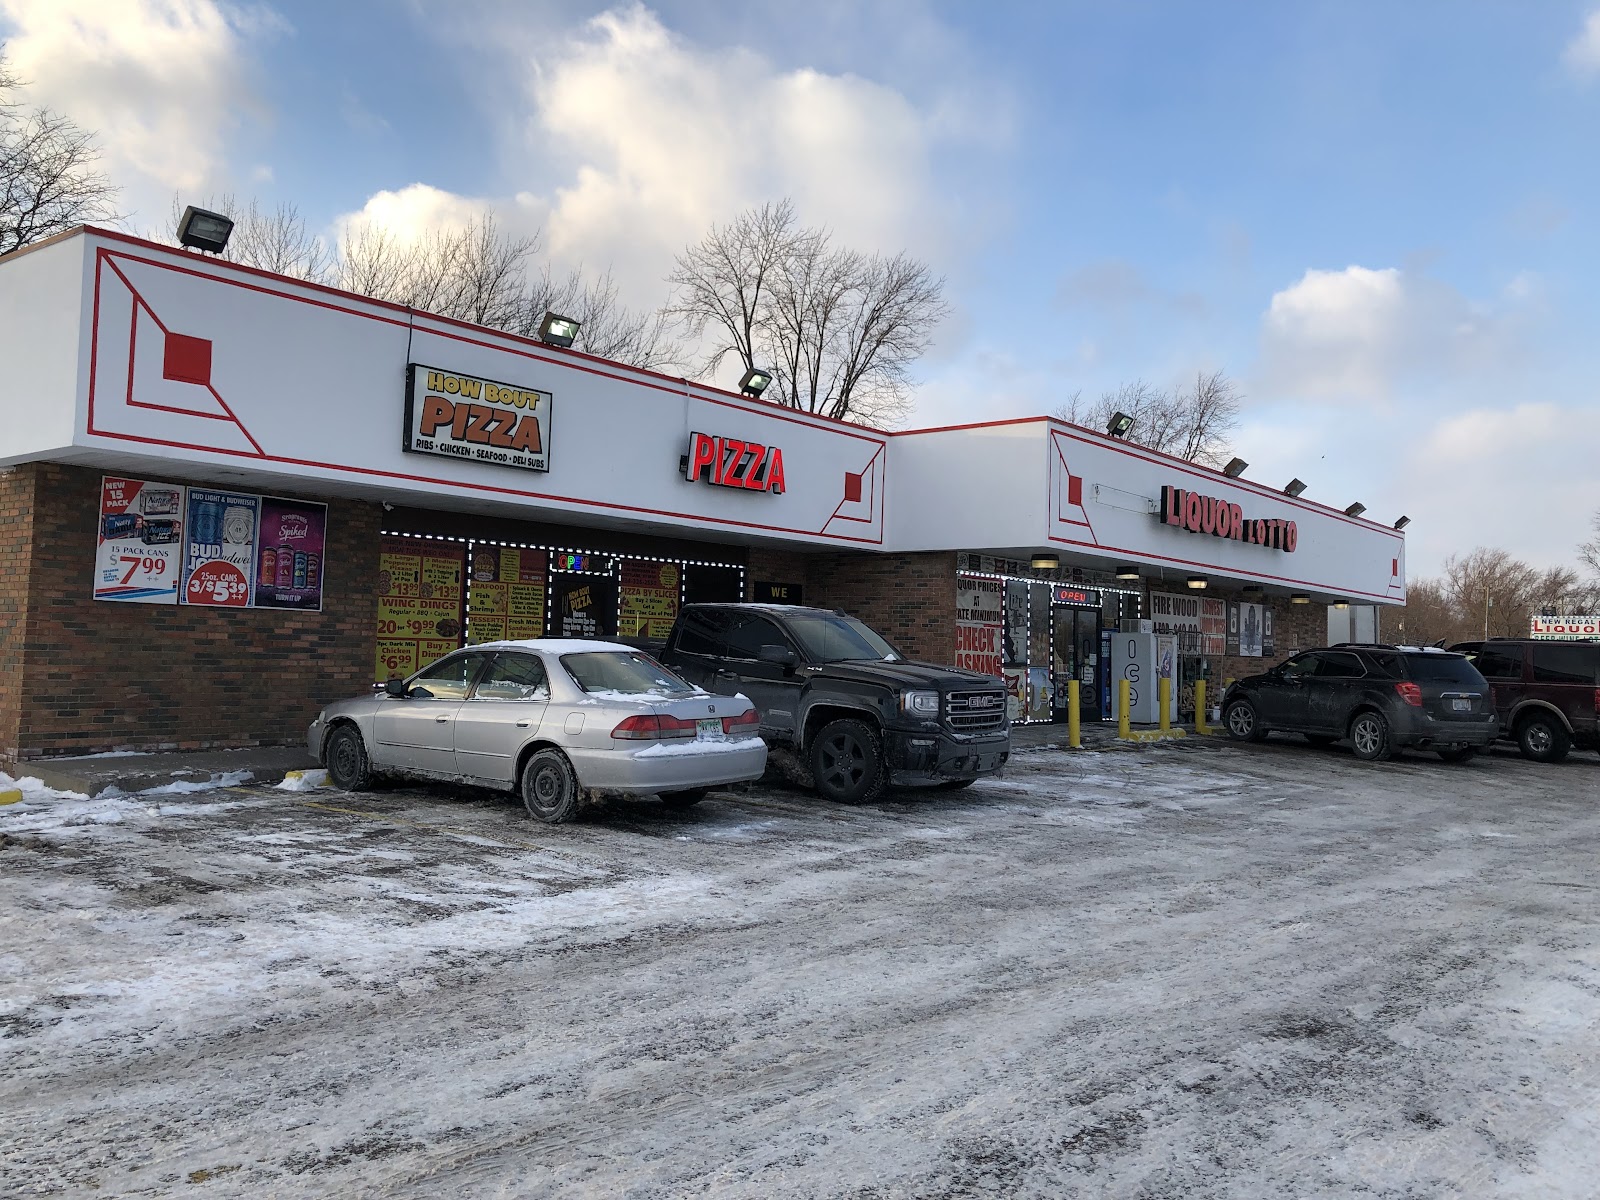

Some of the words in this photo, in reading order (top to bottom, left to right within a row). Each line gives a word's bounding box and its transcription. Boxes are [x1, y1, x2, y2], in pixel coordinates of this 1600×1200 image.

[428, 372, 482, 399] HOW
[484, 384, 540, 410] BOUT
[420, 396, 542, 454] PIZZA
[416, 439, 434, 450] RIBS
[440, 443, 470, 456] CHICKEN
[476, 449, 508, 462] SEAFOOD
[513, 455, 526, 465] DELI
[527, 458, 544, 468] SUBS
[688, 432, 786, 494] PIZZA
[105, 481, 126, 490] NEW
[110, 490, 123, 499] 15
[227, 497, 256, 507] BUDWEISER
[1163, 486, 1243, 540] LIQUOR
[1244, 519, 1297, 552] LOTTO
[279, 524, 308, 541] Spiked
[190, 543, 221, 558] BUD
[559, 554, 590, 570] OPEN
[201, 572, 218, 580] 25oz.
[220, 574, 238, 582] CANS
[771, 587, 787, 598] WE
[958, 579, 977, 590] QUOR
[978, 581, 1001, 593] PRICES
[655, 590, 676, 598] SLICES
[974, 596, 980, 606] AT
[1060, 590, 1086, 602] OPEN
[382, 598, 416, 608] WING
[420, 600, 456, 610] DINGS
[570, 595, 592, 611] PIZZA
[1153, 596, 1170, 614] FIRE
[1172, 599, 1198, 617] WOOD
[957, 609, 969, 620] ATE
[378, 620, 396, 634] 20
[1534, 620, 1600, 633] LIQUO
[427, 642, 443, 650] Buy
[955, 626, 995, 652] CHECK
[957, 654, 1001, 677] ASHING
[968, 696, 994, 707] GMC
